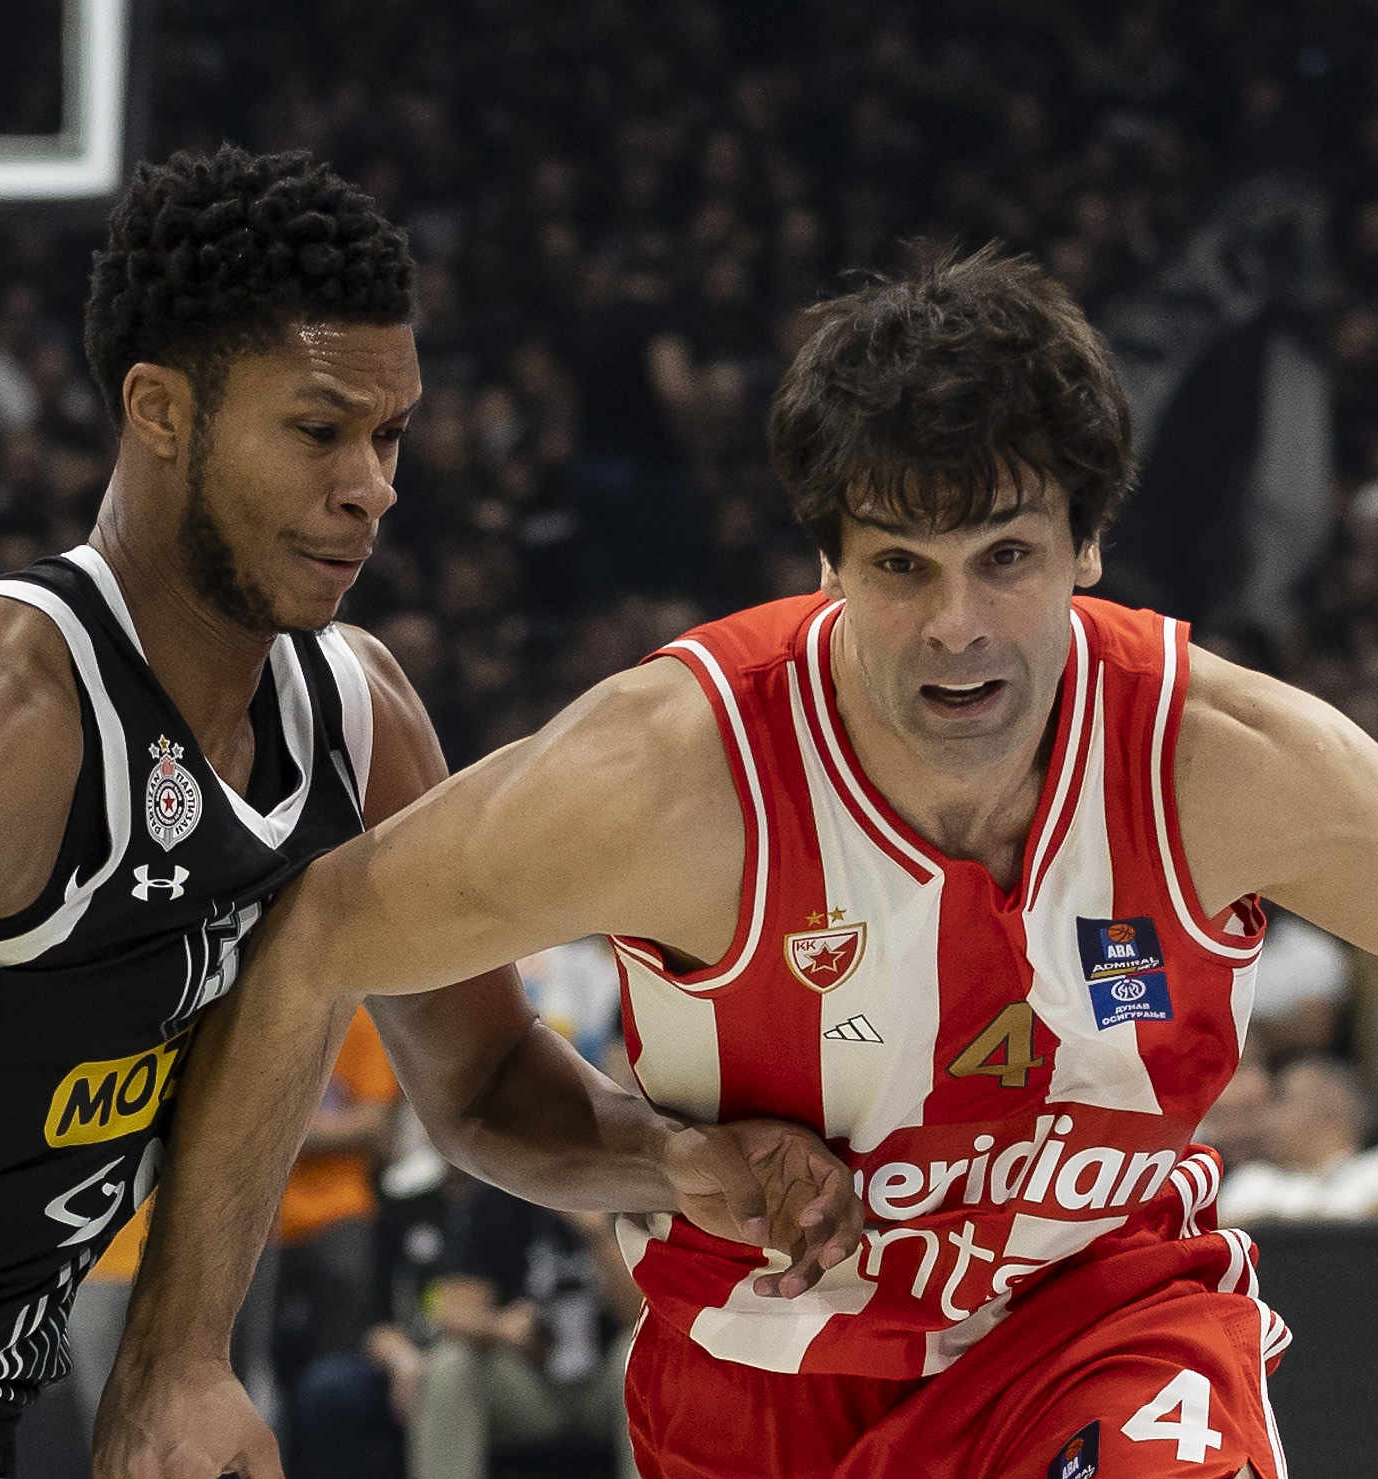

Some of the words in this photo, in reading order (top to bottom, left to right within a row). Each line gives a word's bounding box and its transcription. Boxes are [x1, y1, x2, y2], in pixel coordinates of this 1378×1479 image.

[1093, 957, 1157, 973] ADMIRAL
[1107, 944, 1136, 959] ABA
[946, 999, 1047, 1088] 4
[854, 1114, 1177, 1221] eridian
[1120, 1368, 1222, 1464] 4
